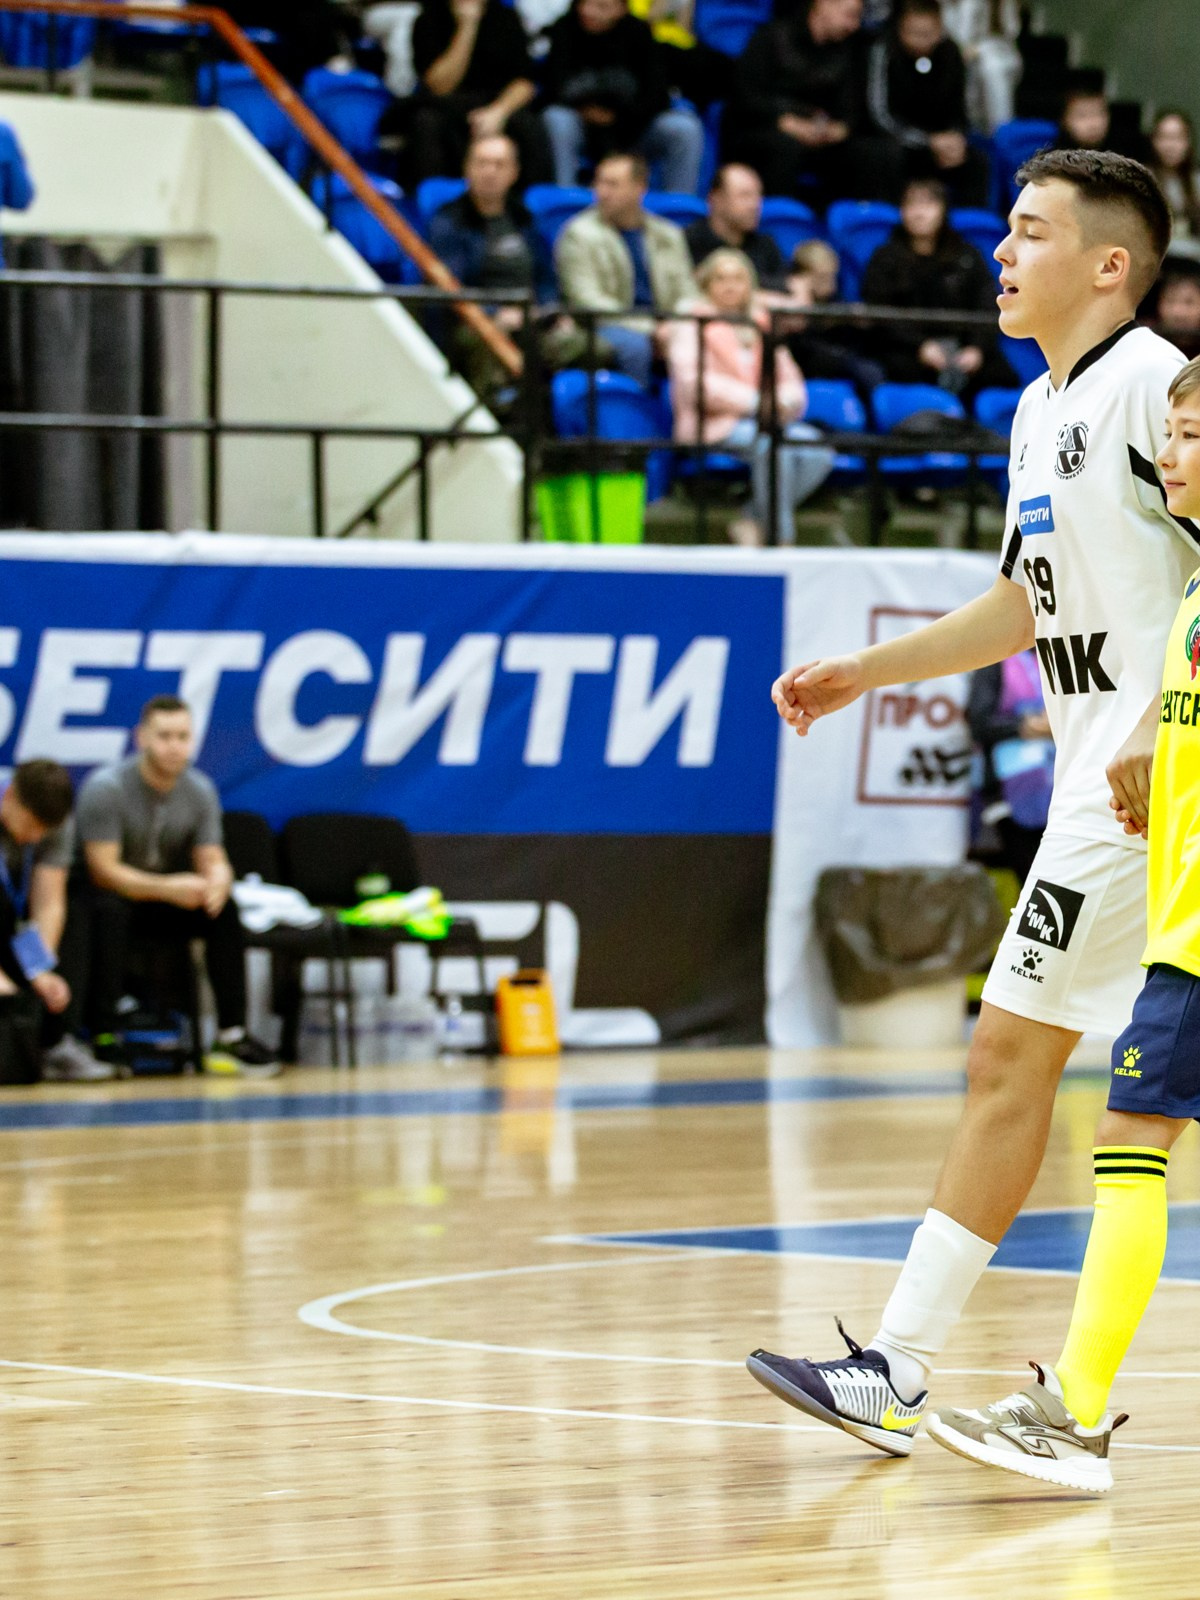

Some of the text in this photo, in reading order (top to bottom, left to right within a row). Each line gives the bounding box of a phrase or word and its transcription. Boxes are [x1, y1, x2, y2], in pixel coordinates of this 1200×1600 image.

[0, 626, 731, 769] ЕТСИТИ
[877, 693, 970, 729] ПРО
[1026, 902, 1055, 942] ТМК
[1010, 964, 1045, 984] KELME
[1114, 1067, 1143, 1079] KELME
